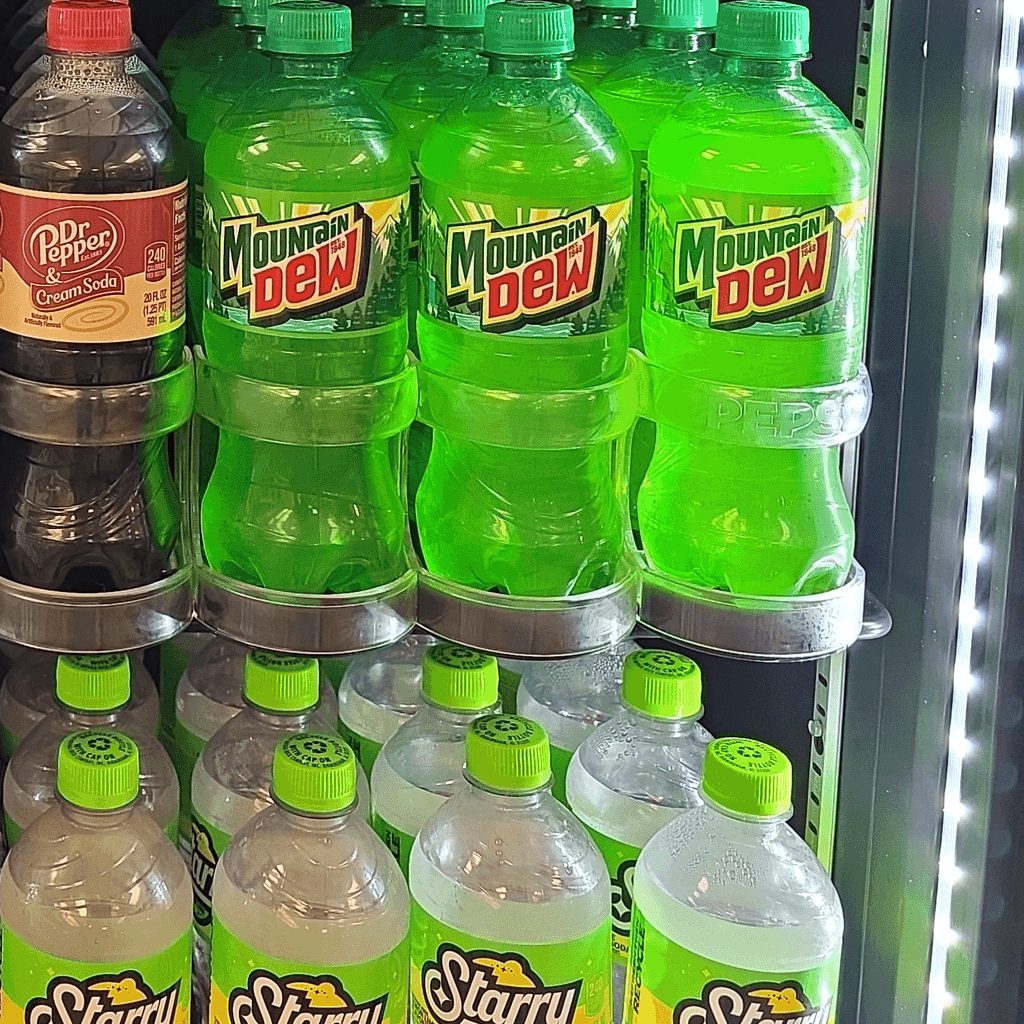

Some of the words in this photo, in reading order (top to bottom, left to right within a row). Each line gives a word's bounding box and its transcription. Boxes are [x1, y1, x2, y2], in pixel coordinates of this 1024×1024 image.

[59, 219, 90, 239] Dr
[30, 223, 110, 266] Pepper
[148, 247, 165, 264] 240
[46, 268, 61, 284] &
[36, 286, 81, 306] Cream
[83, 273, 117, 294] Soda
[144, 293, 151, 303] 20
[706, 396, 844, 438] PEPS
[86, 752, 102, 760] CAP
[289, 744, 302, 756] WITH
[301, 754, 317, 762] CAP
[425, 950, 576, 1024] Starry
[233, 976, 383, 1024] Starry
